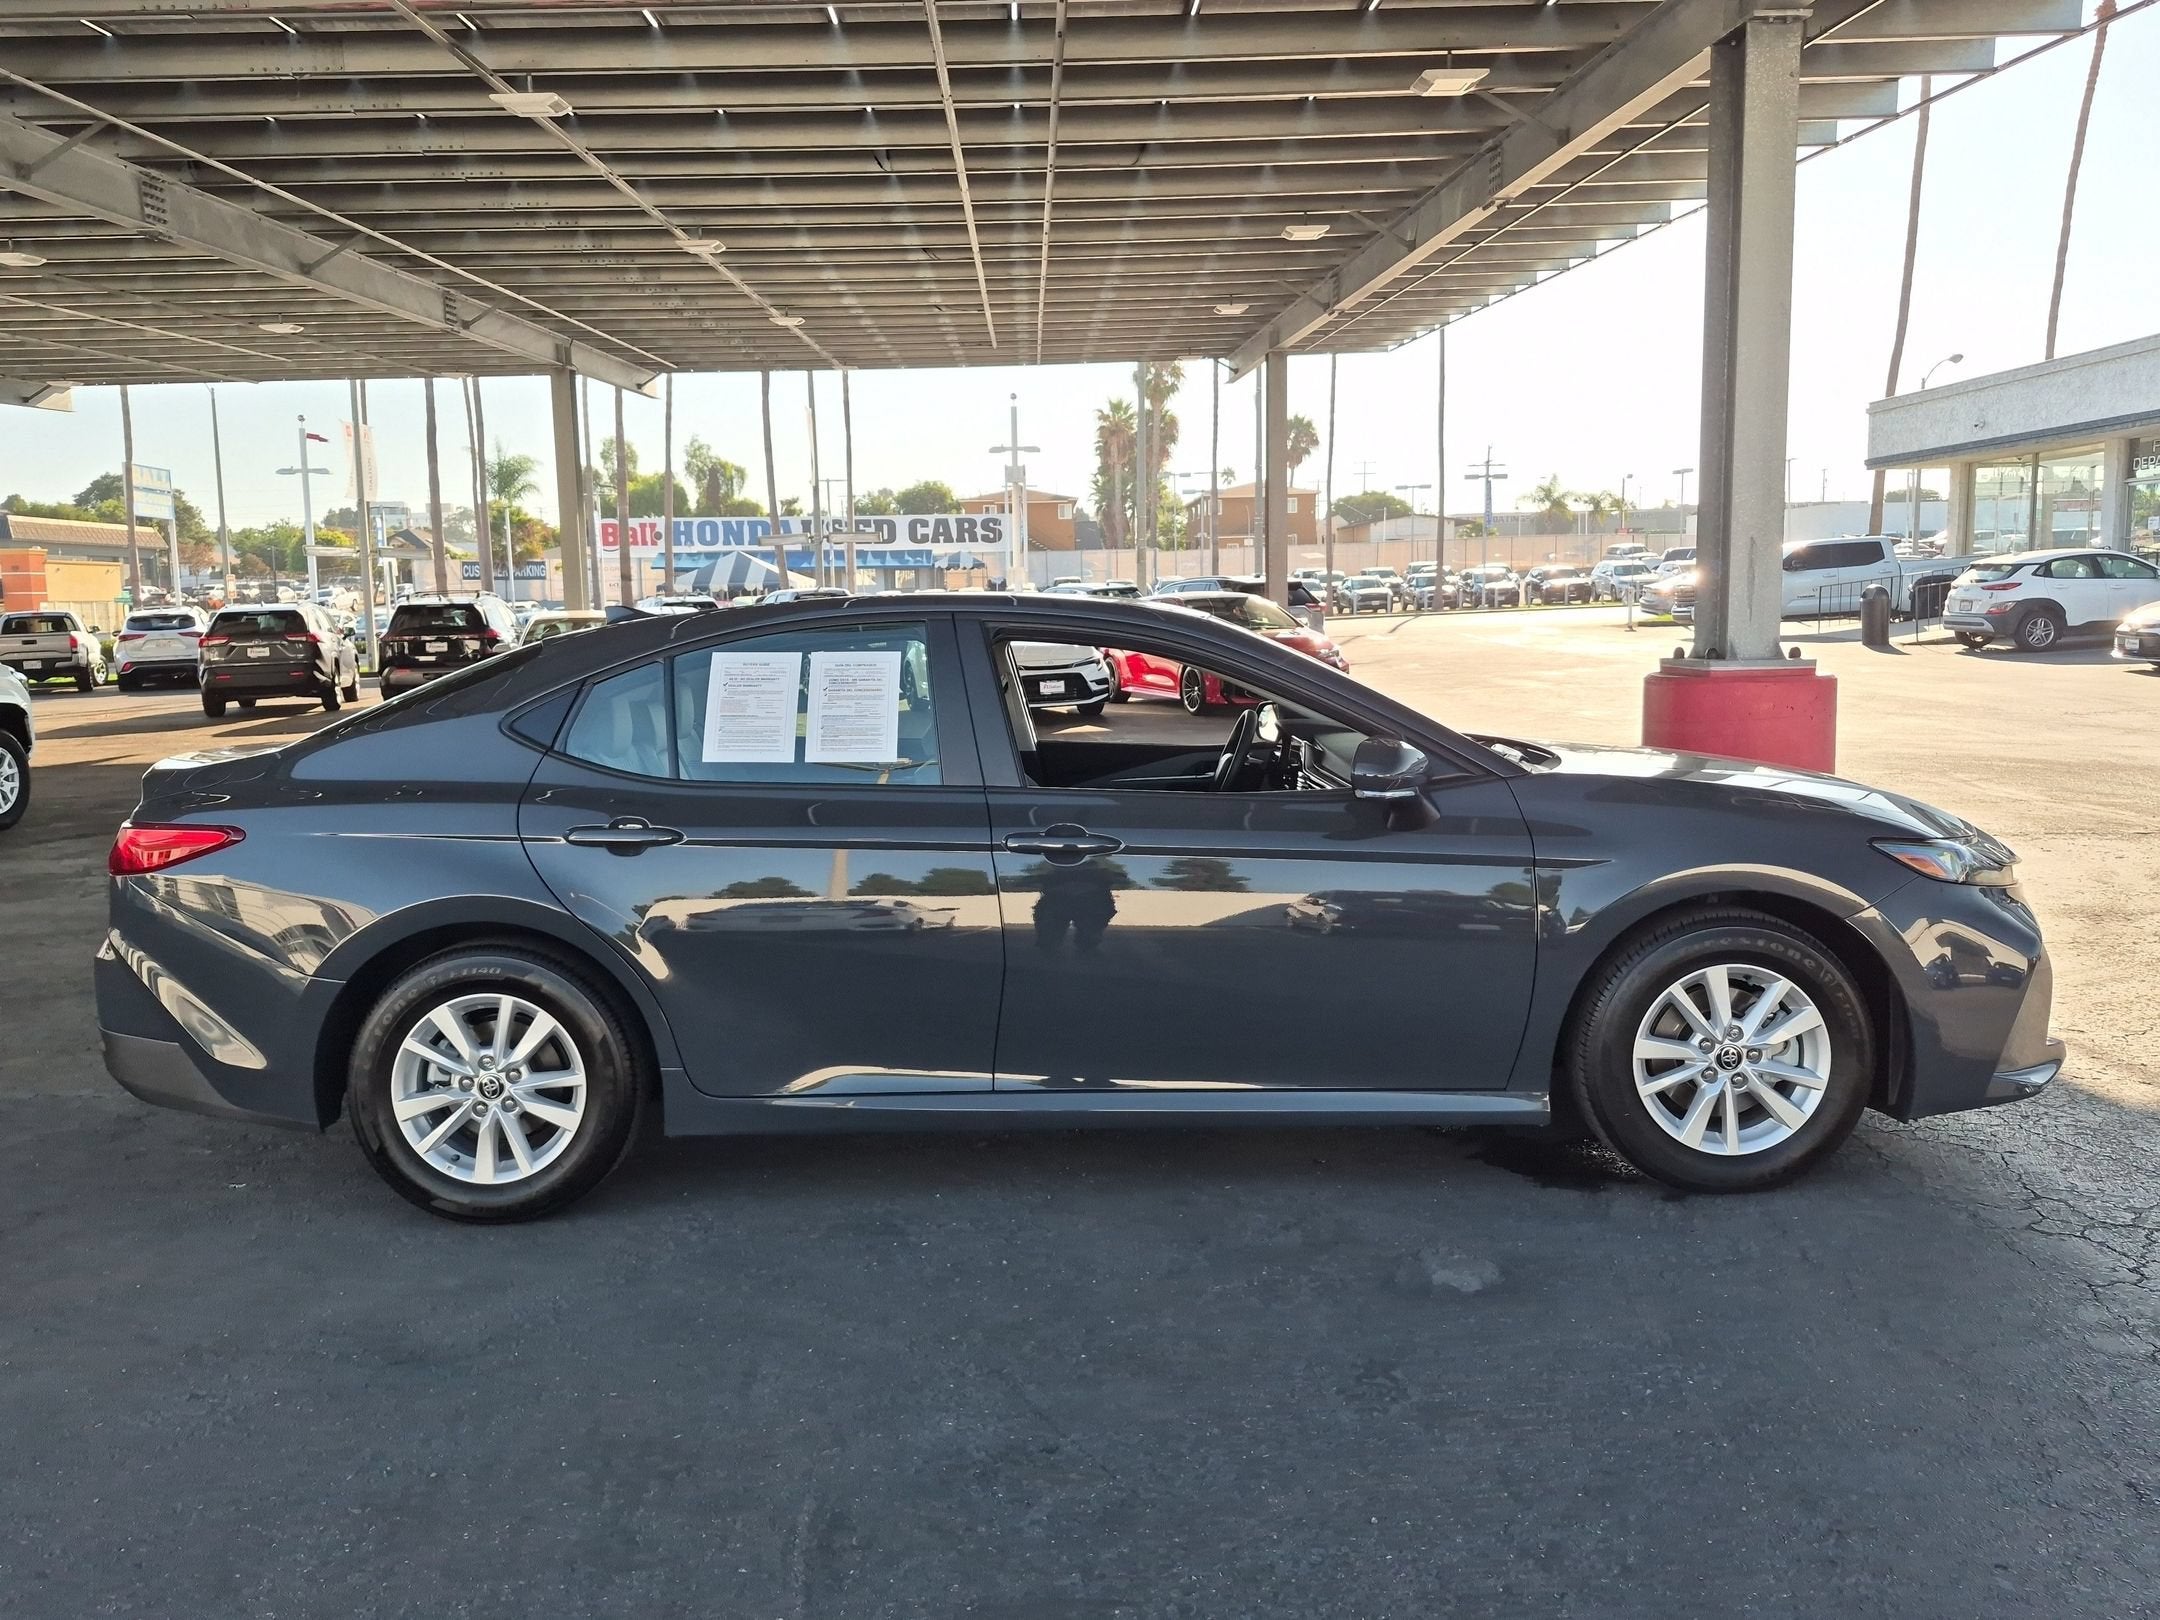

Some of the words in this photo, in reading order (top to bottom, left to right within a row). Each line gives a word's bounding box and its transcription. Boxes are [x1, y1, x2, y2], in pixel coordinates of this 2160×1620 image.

[602, 522, 658, 547] Ball
[908, 517, 1003, 544] CARS
[511, 564, 546, 577] ARKING
